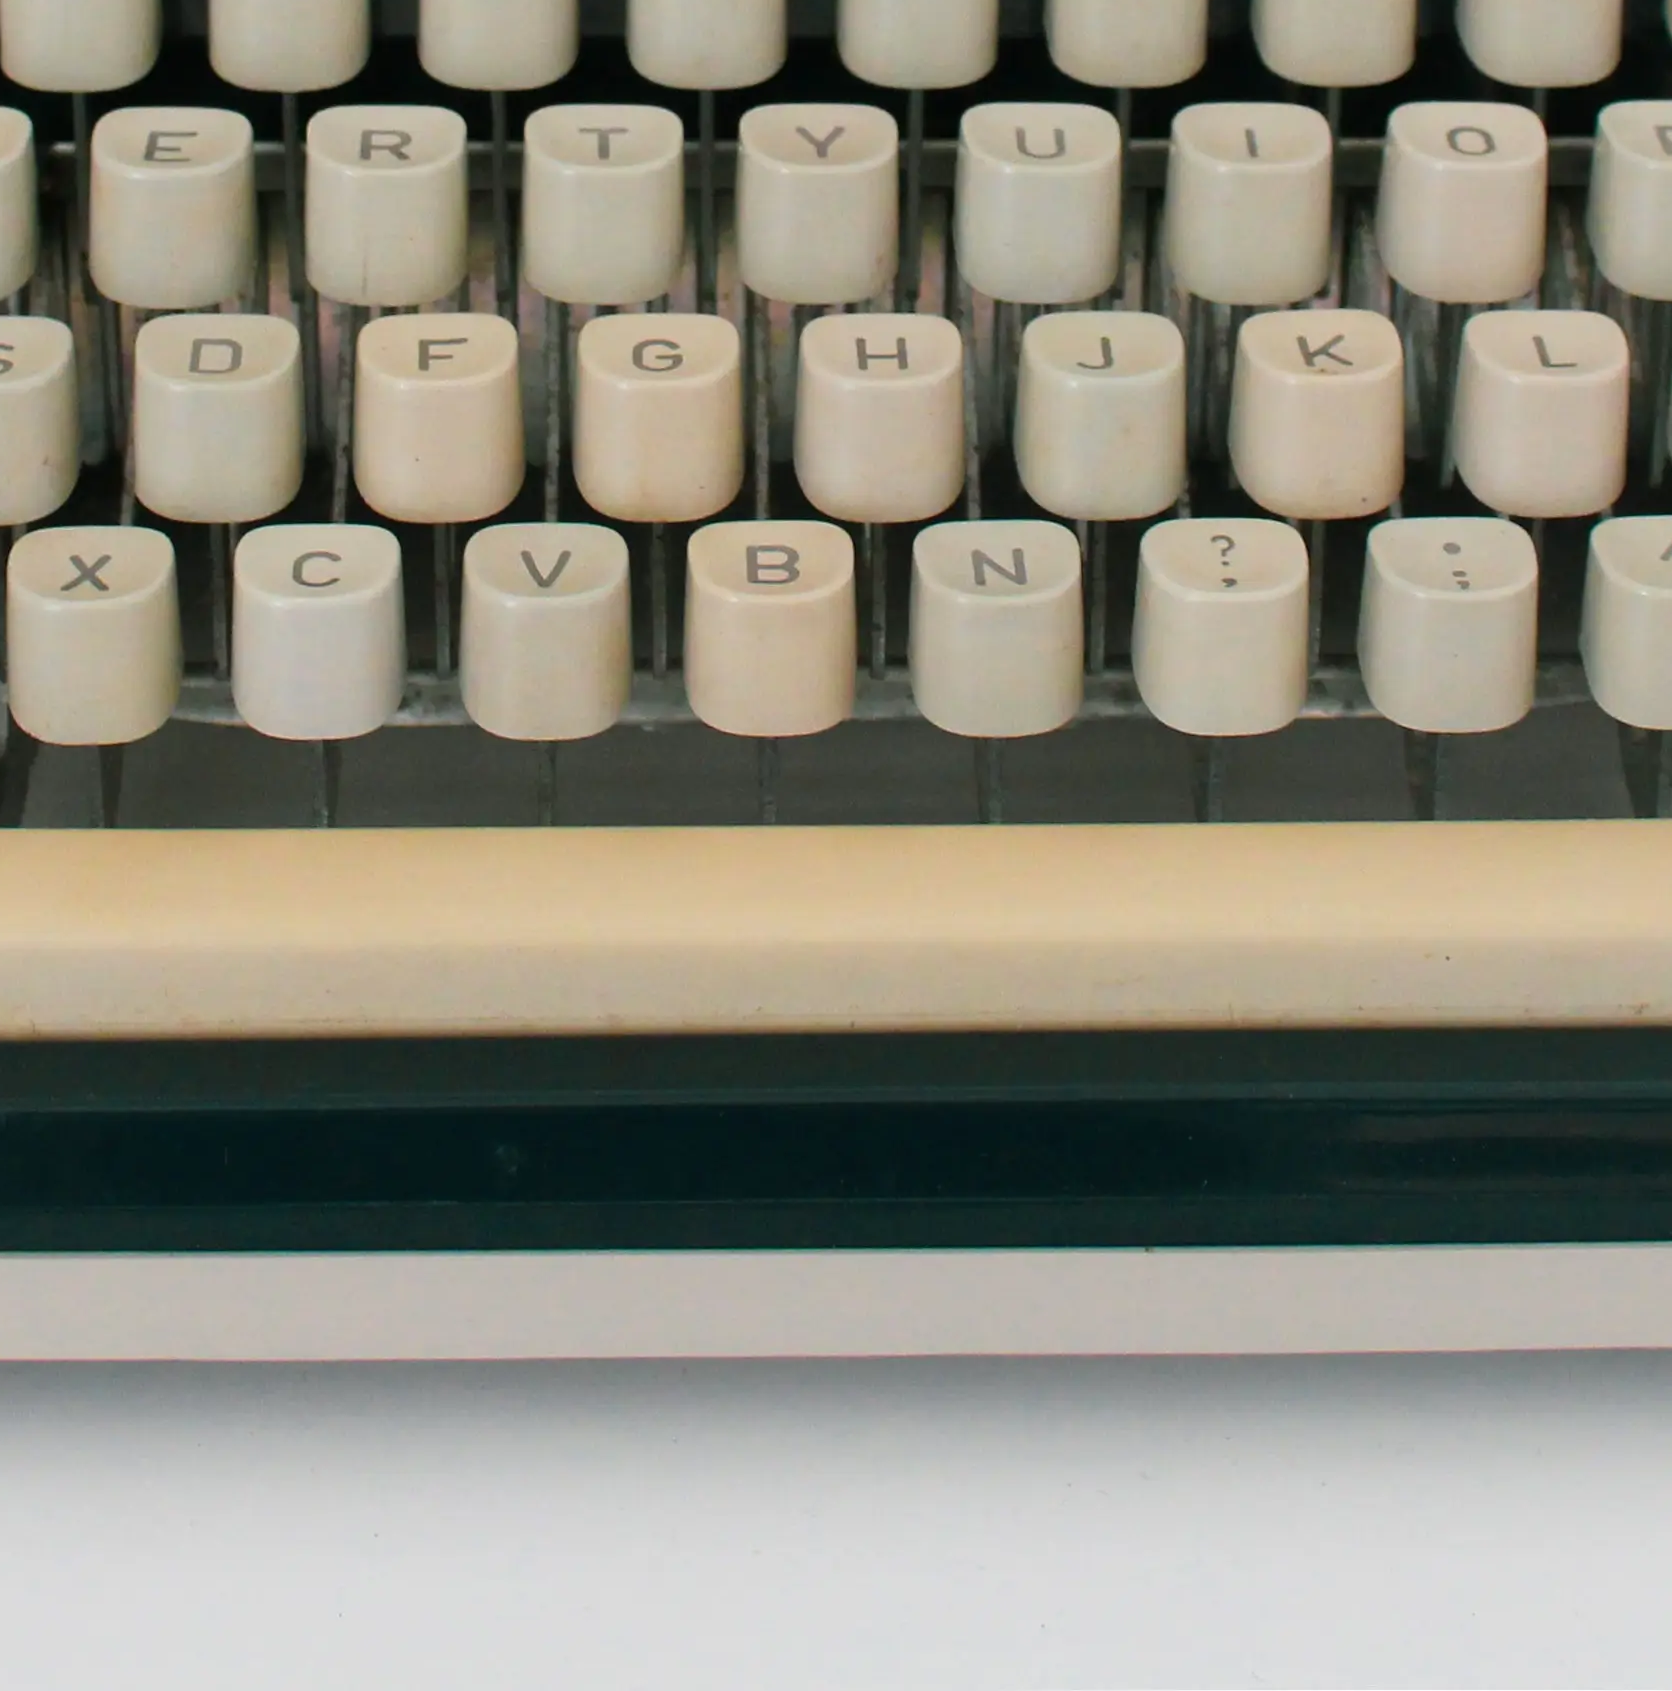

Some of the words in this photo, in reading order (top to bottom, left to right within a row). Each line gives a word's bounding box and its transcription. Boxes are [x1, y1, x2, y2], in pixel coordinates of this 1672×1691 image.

[143, 131, 197, 163] E
[359, 130, 410, 161] R
[579, 128, 628, 160] T
[796, 126, 845, 159] Y
[1016, 128, 1066, 159] U
[189, 339, 242, 375] D
[418, 338, 468, 371] F
[632, 339, 682, 372] G
[856, 337, 906, 370] H
[1077, 337, 1114, 370] J
[1297, 335, 1353, 367] K
[1532, 336, 1576, 368] L
[746, 545, 798, 585] B
[1211, 535, 1235, 566] ?
[60, 555, 110, 592] X
[292, 551, 341, 587] C
[521, 550, 571, 589] V
[971, 548, 1027, 587] N
